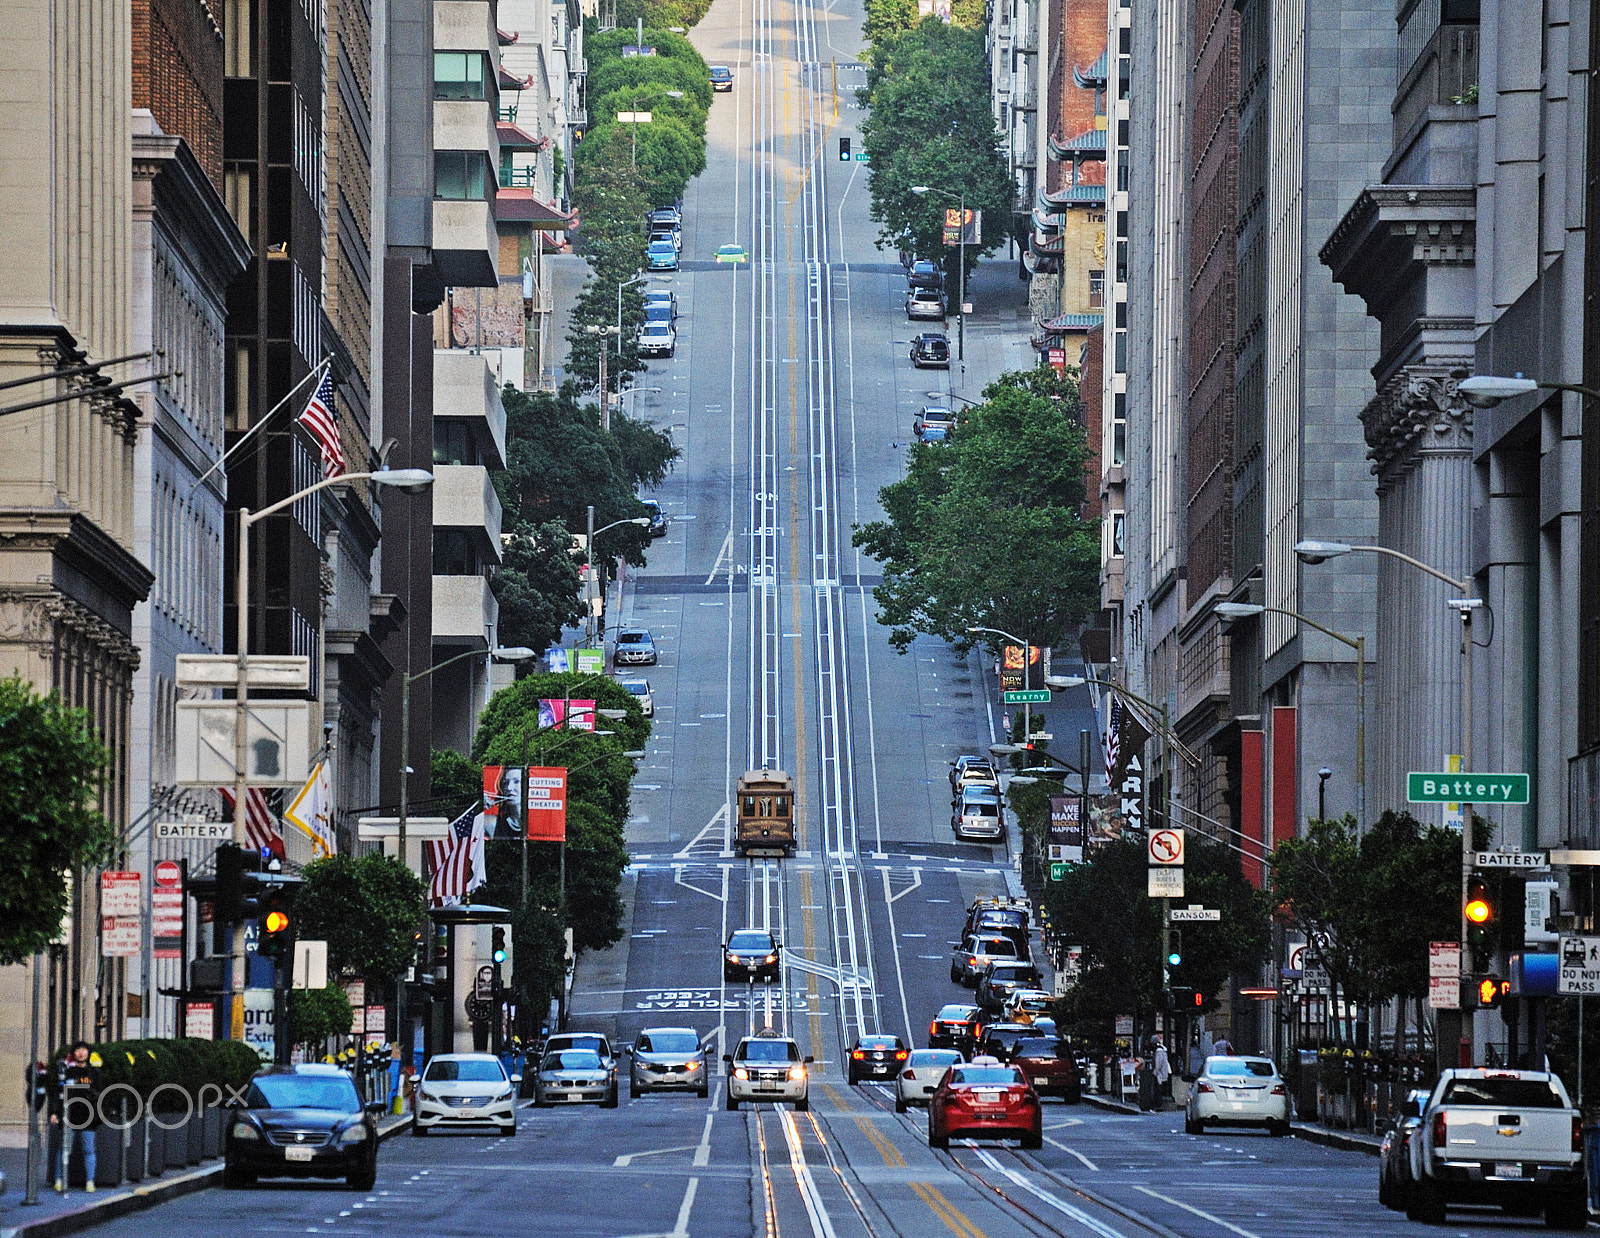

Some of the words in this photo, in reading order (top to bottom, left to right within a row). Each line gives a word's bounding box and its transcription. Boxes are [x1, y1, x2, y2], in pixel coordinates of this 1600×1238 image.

[1009, 693, 1045, 701] Kearny
[1121, 754, 1142, 815] ARK
[1423, 780, 1512, 800] Battery
[1063, 804, 1080, 813] WE
[1051, 812, 1080, 821] MAKE
[160, 826, 228, 836] BATTERY
[1479, 854, 1542, 865] BATTERY
[103, 880, 114, 888] NO
[1173, 911, 1218, 919] SANSOME
[104, 919, 114, 929] NO
[1562, 970, 1576, 979] DO
[1581, 970, 1600, 979] NOT
[1568, 982, 1595, 991] PASS
[646, 991, 711, 1000] KEEP
[636, 1000, 720, 1009] CLEAR
[246, 1028, 274, 1042] Extr
